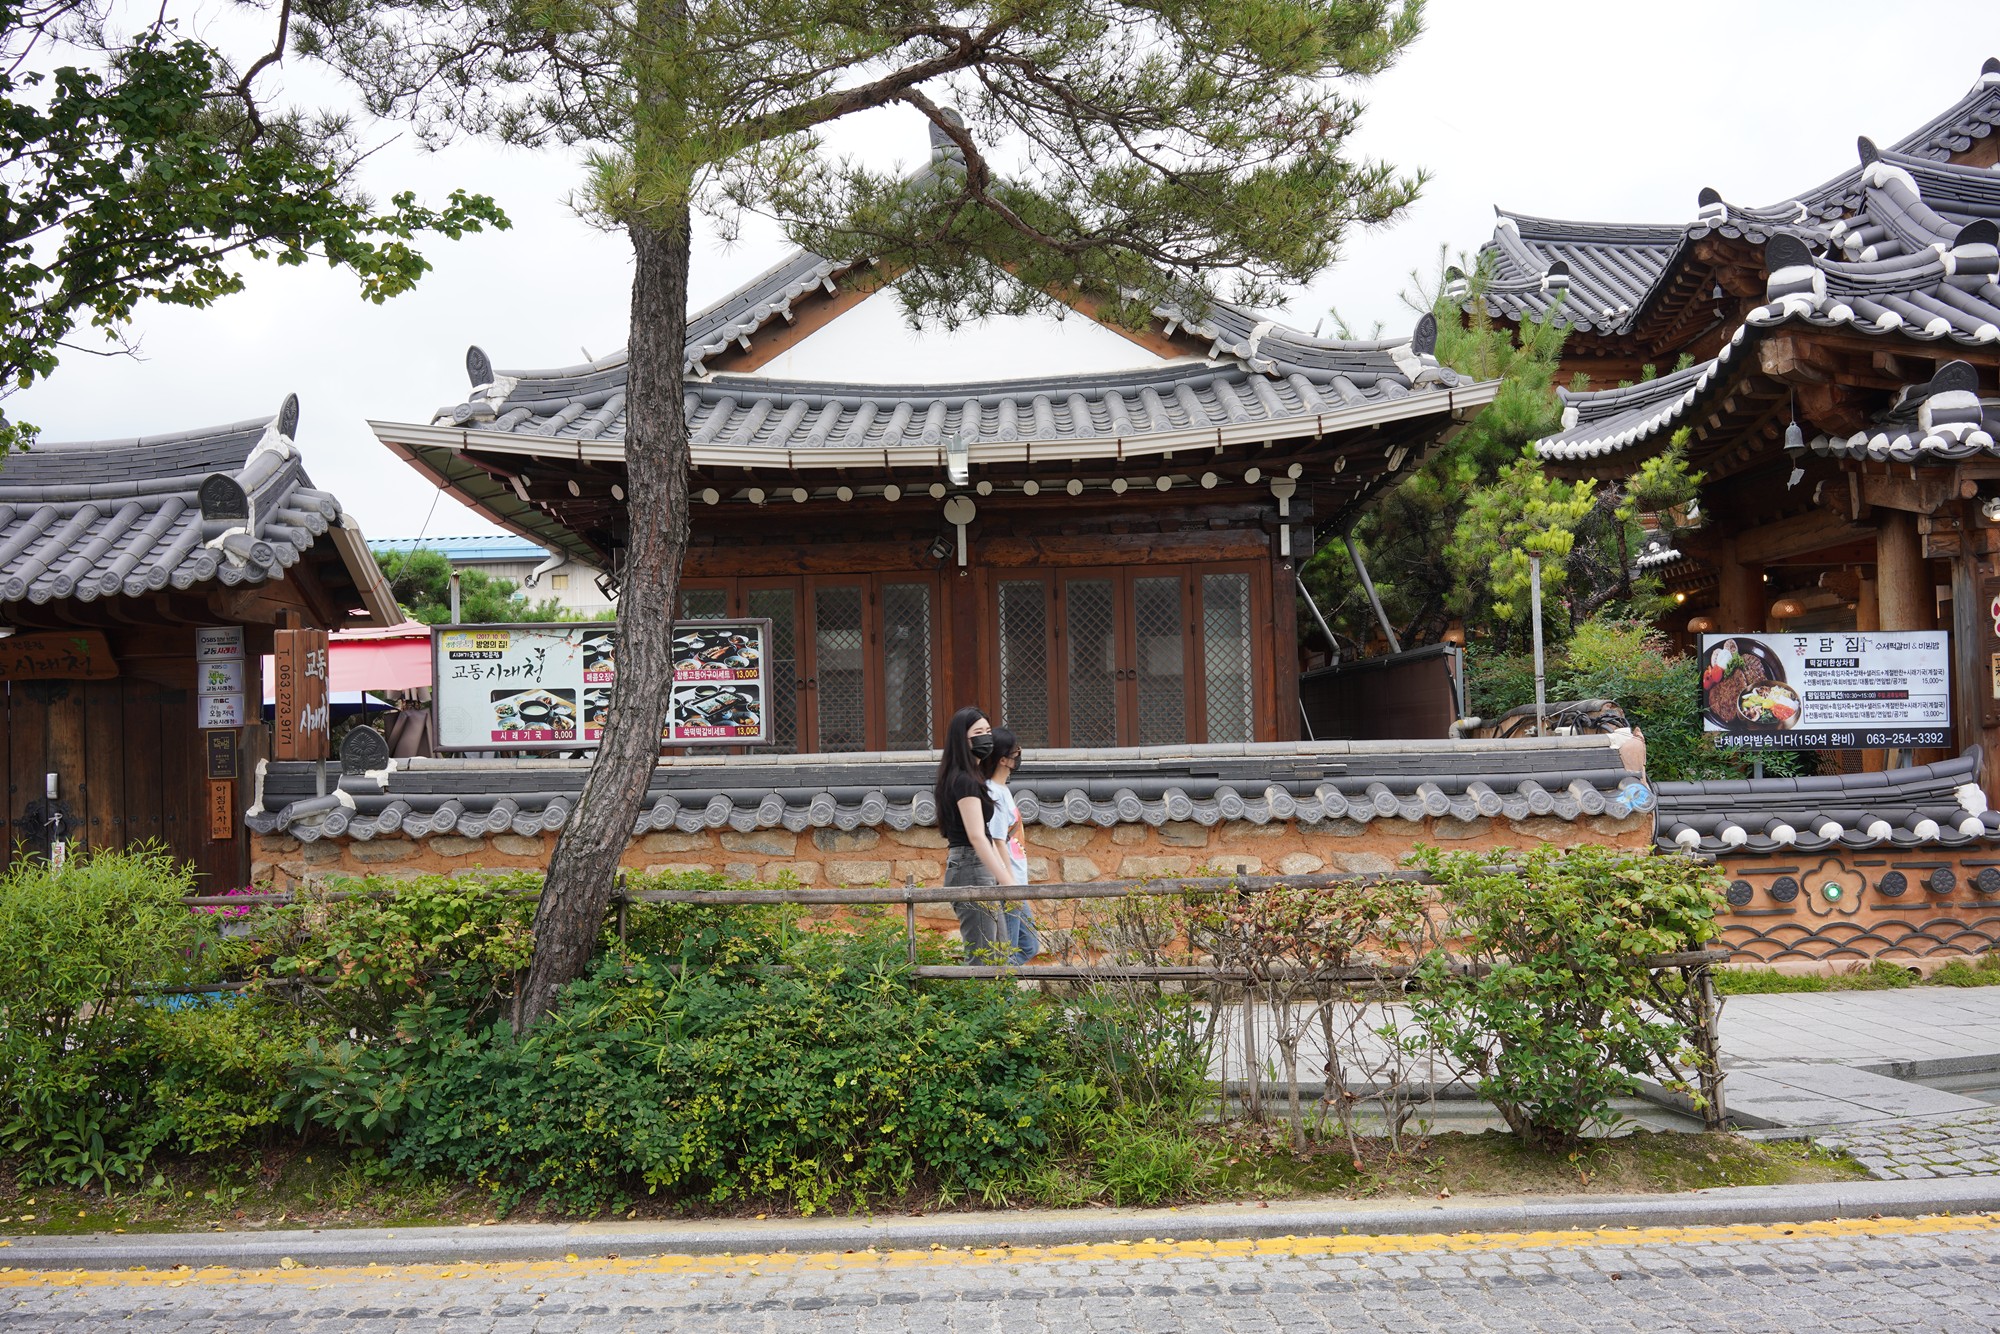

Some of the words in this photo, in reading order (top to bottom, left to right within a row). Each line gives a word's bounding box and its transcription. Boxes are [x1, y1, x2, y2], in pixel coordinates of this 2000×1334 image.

[476, 640, 496, 649] 방영의
[498, 640, 508, 649] 집!
[1875, 642, 1911, 651] 수제떡갈비
[1918, 642, 1940, 651] 비빔밥
[305, 648, 326, 681] 교동
[736, 669, 758, 678] 13,000
[279, 667, 292, 745] 063.273.9171
[554, 731, 573, 740] 8,000
[737, 726, 759, 736] 13,000
[1831, 732, 1855, 746] 완비)
[1866, 732, 1944, 745] 063-254-3392
